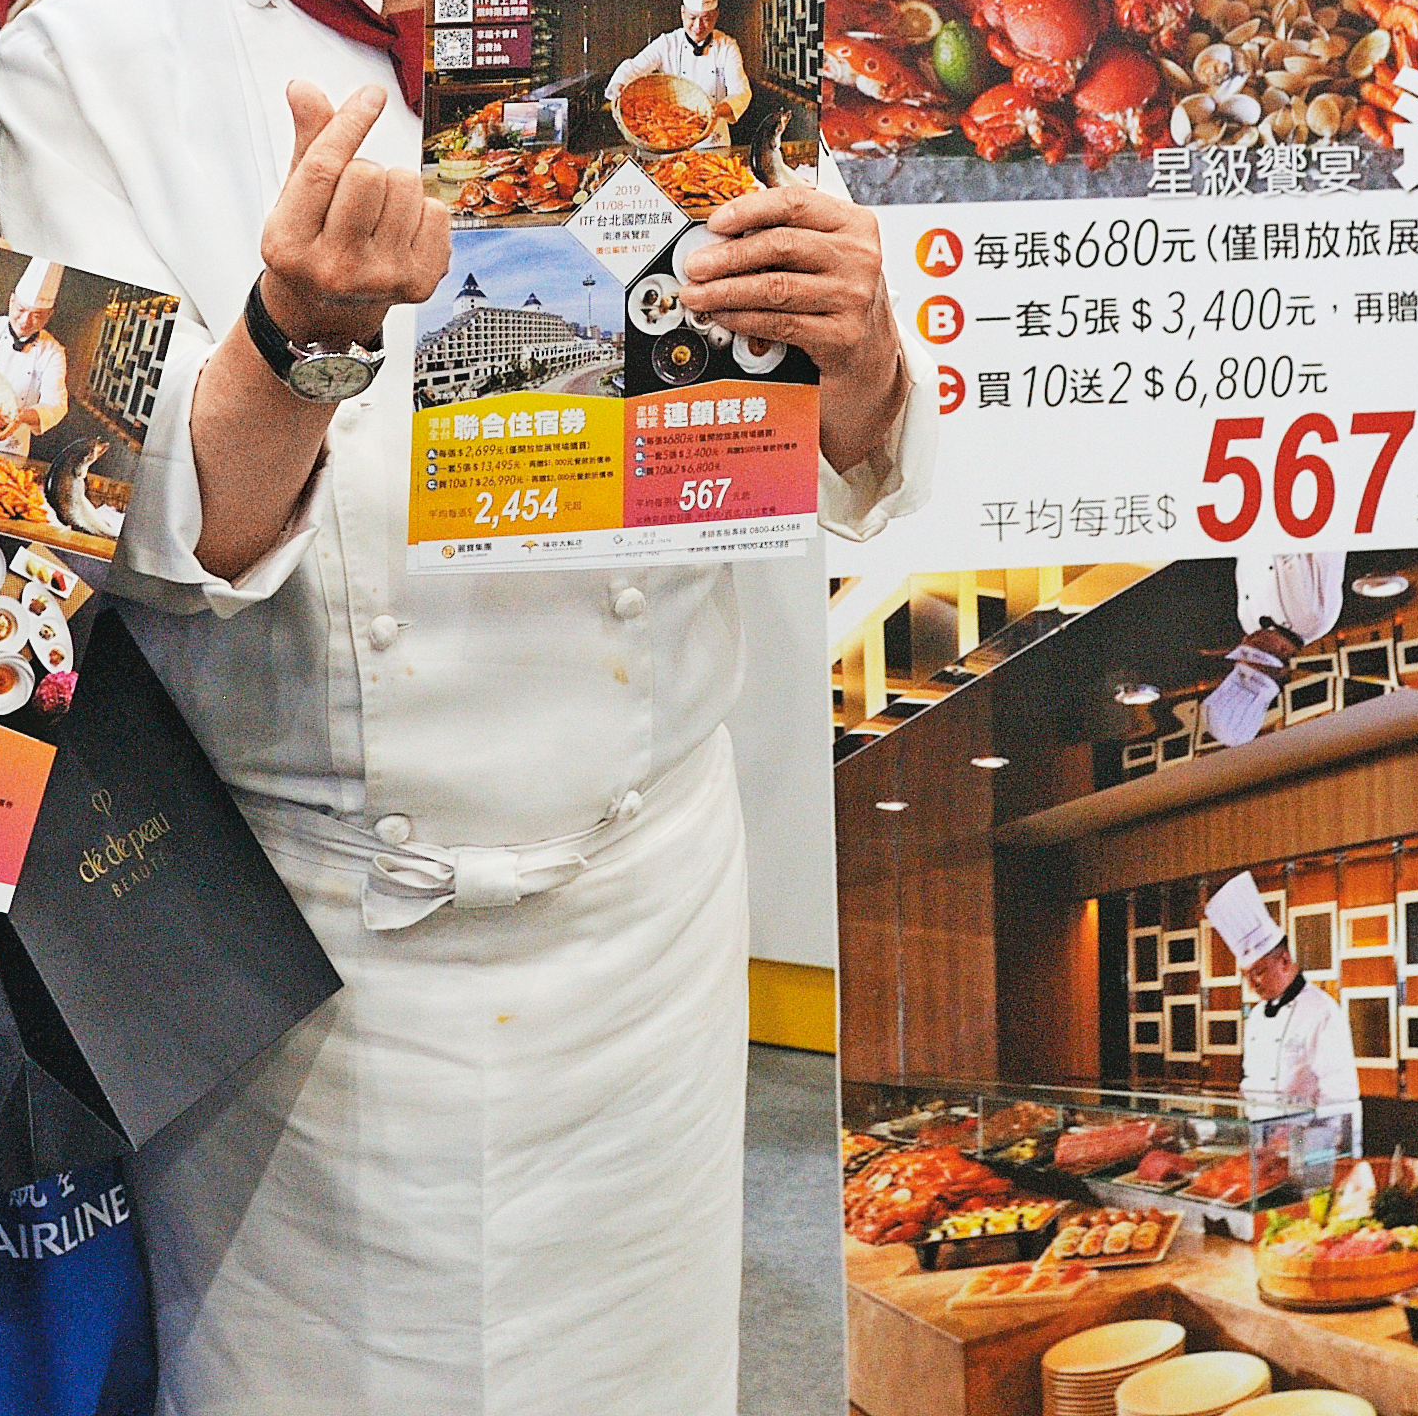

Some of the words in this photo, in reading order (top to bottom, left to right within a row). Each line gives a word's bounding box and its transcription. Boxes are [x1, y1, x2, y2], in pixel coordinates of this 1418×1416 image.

[1146, 143, 1362, 200] 星級饗宴
[595, 199, 659, 211] 11/08~11/11
[615, 185, 640, 196] 2019
[579, 212, 673, 227] ITF台北國際旅展
[632, 244, 656, 253] N1702
[925, 235, 957, 267] A
[928, 305, 956, 337] B
[453, 408, 587, 441] 聯合住宿券
[664, 396, 767, 429] 連鎖餐券
[980, 494, 1178, 542] 平均每張$
[1196, 410, 1416, 543] 567
[474, 488, 559, 529] 2,454
[679, 477, 732, 512] 567
